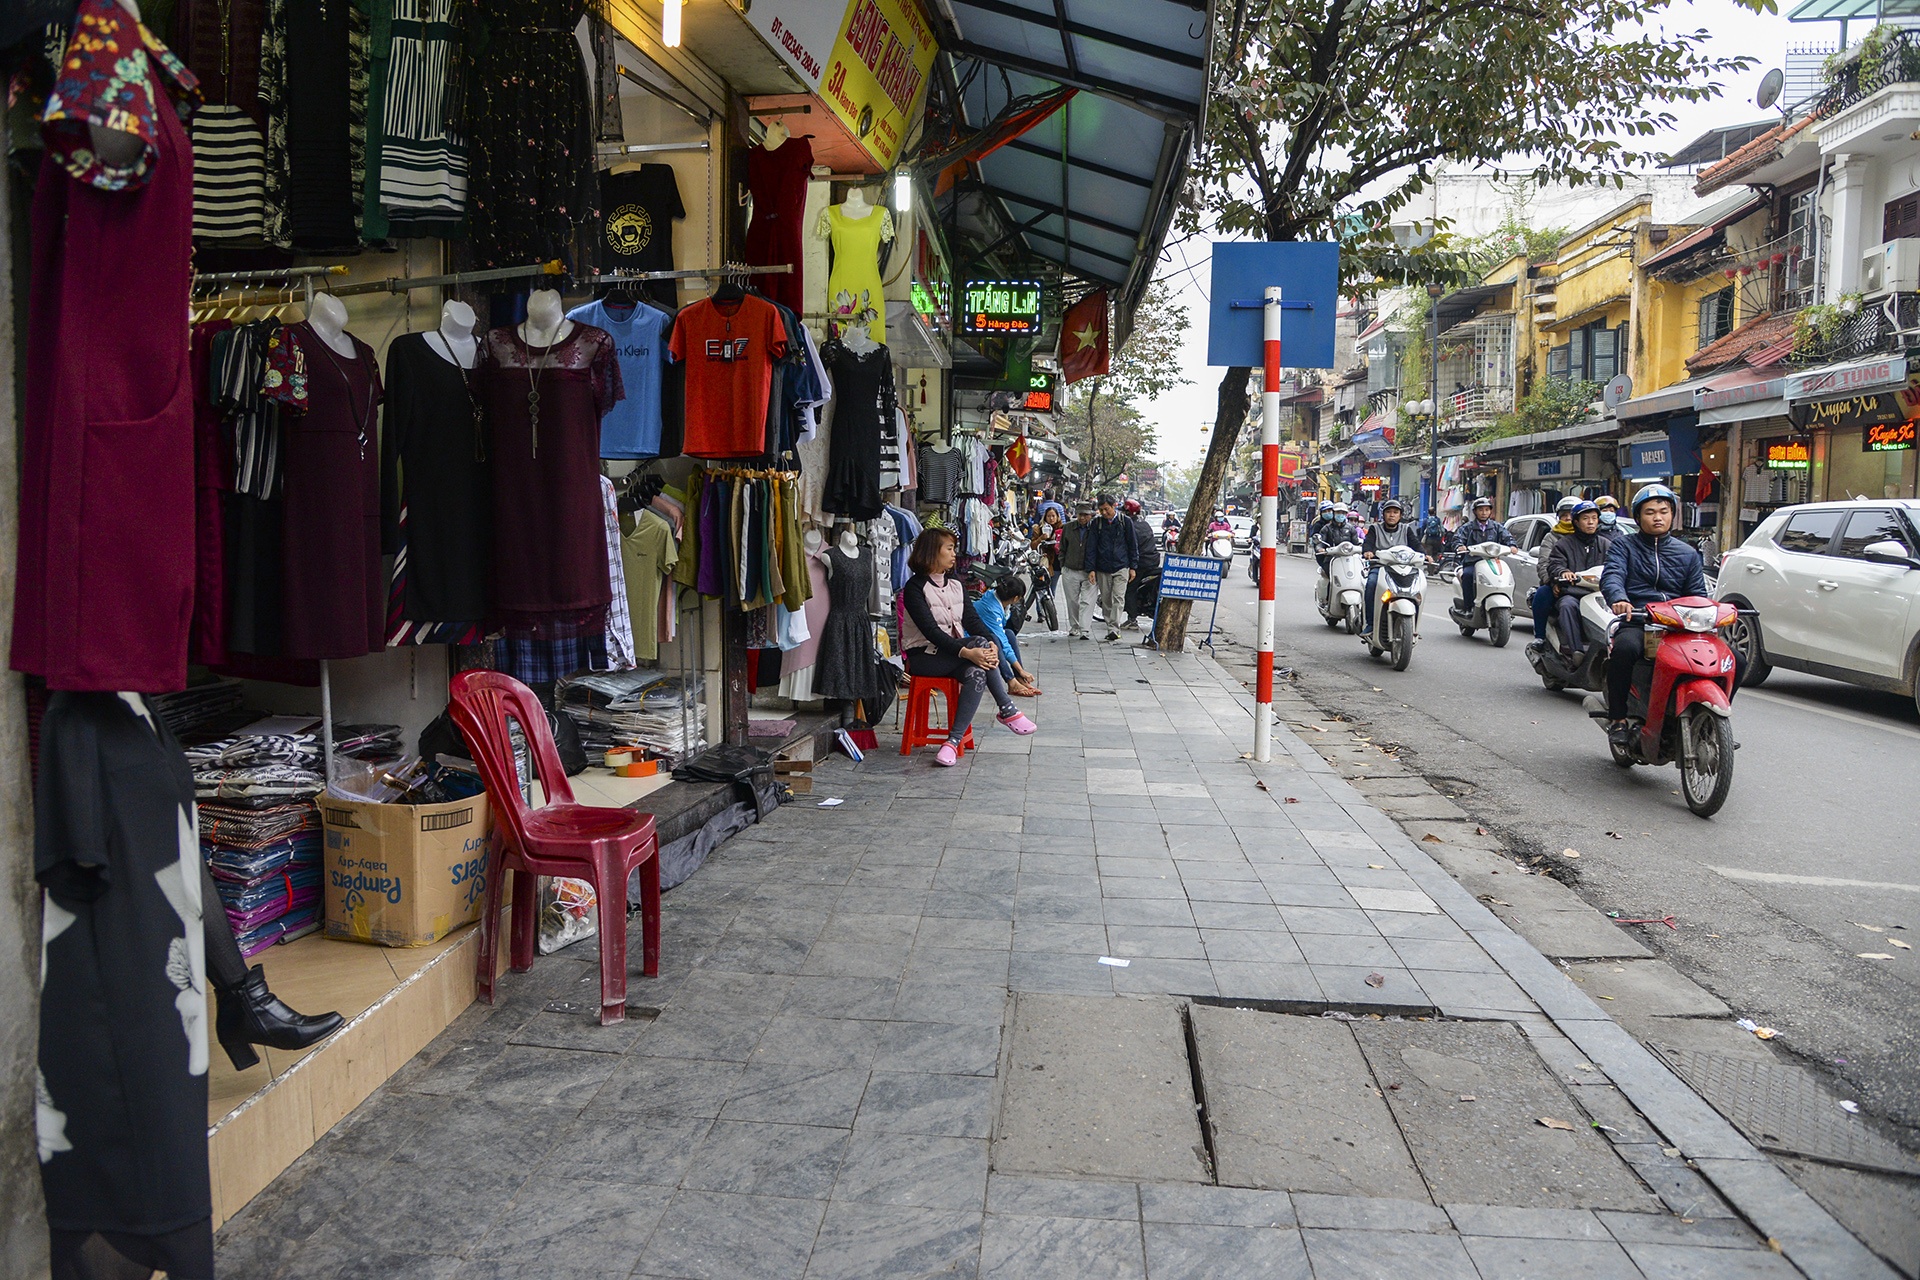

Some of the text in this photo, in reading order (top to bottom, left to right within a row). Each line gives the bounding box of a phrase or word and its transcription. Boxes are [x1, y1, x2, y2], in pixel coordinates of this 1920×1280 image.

[811, 62, 821, 80] 66
[828, 60, 847, 100] 3A
[975, 313, 987, 328] 5
[988, 320, 1010, 329] Hàng
[624, 344, 650, 357] Klein
[338, 855, 388, 873] baby-dry
[331, 871, 402, 904] Pampers
